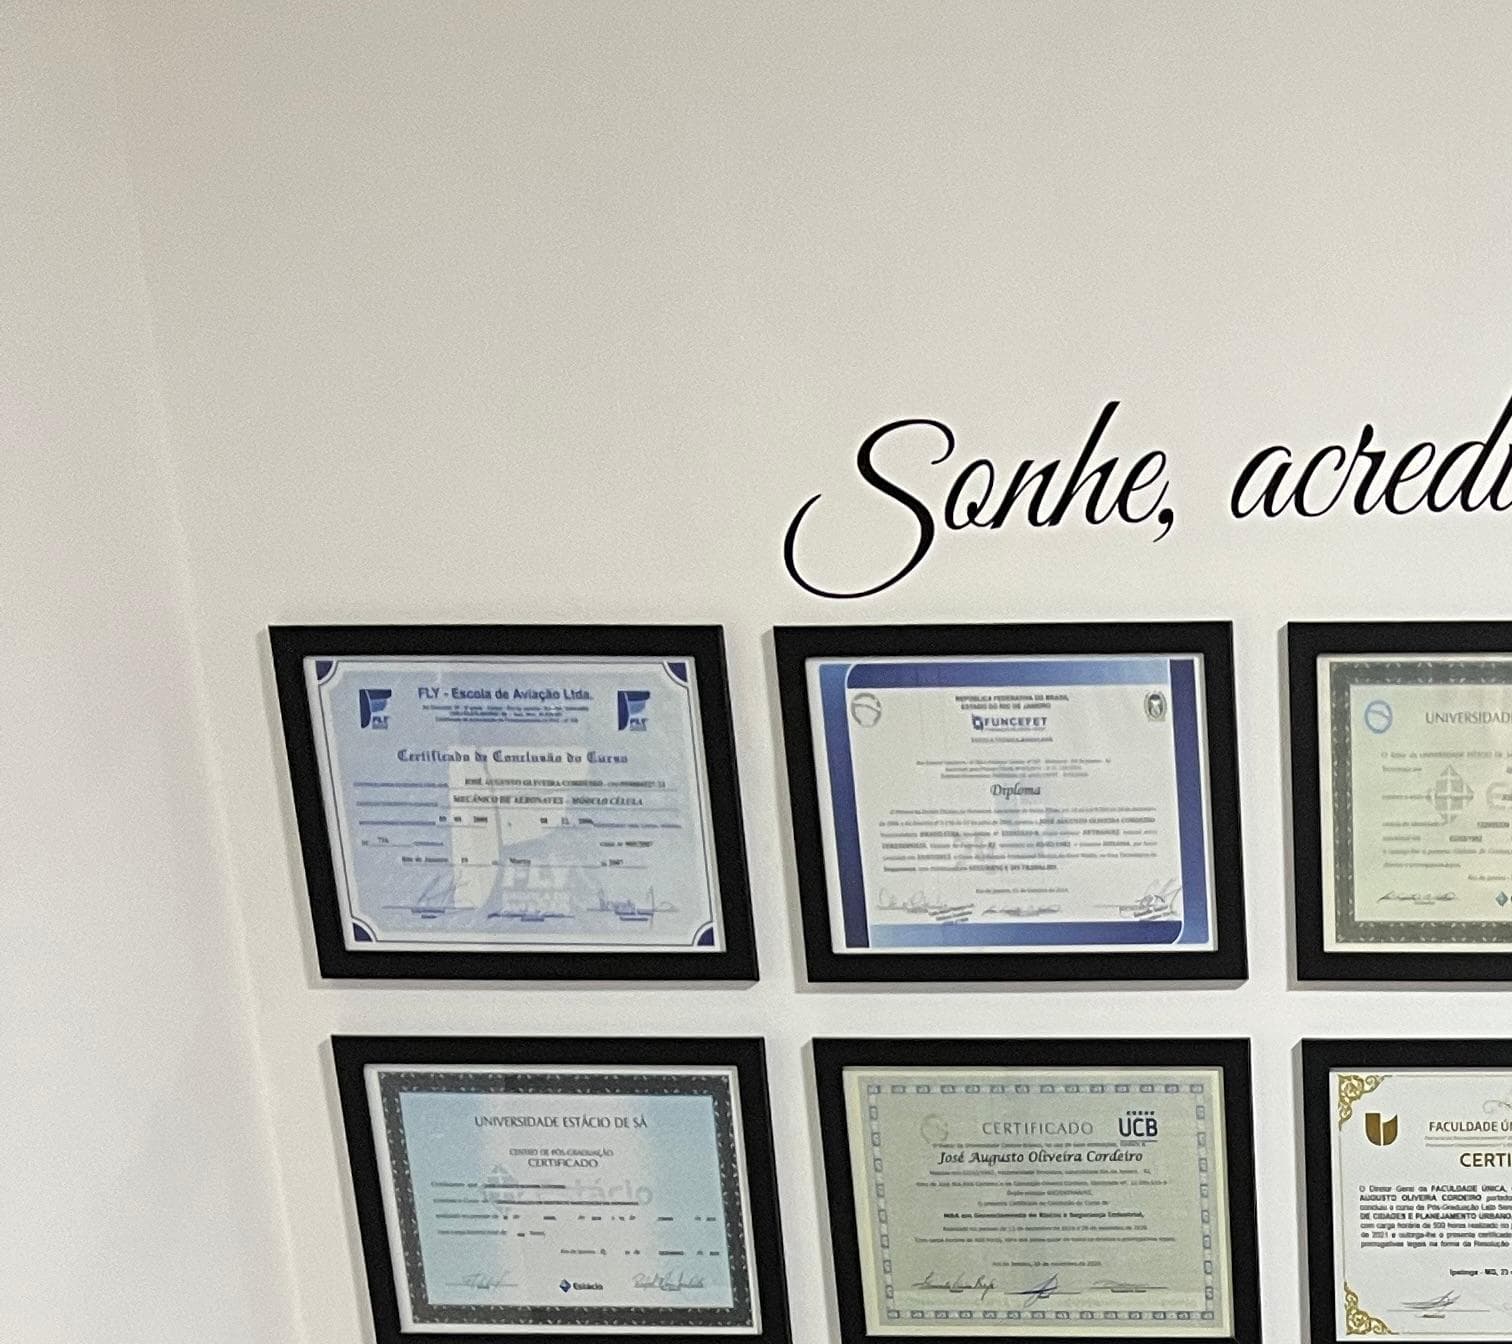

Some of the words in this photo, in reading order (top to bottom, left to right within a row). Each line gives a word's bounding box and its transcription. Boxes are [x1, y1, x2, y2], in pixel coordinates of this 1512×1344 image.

[784, 407, 1173, 599] Sonhe,
[418, 687, 440, 699] FLY
[452, 687, 492, 699] Escola
[495, 688, 509, 699] de
[514, 689, 560, 701] Aviação
[563, 689, 592, 700] Ltda.
[984, 717, 1046, 726] FUNCEFET
[398, 750, 470, 764] Certificado
[475, 751, 487, 762] de
[493, 750, 561, 762] Conclusão
[567, 753, 581, 763] do
[587, 751, 628, 763] Curso
[990, 783, 1040, 800] Diploma
[475, 1116, 558, 1127] UNIVERSIDADE
[563, 1115, 610, 1128] ESTÁCIO
[614, 1117, 629, 1128] DE
[633, 1115, 648, 1128] SÁ
[982, 1121, 1093, 1136] CERTIFICADO
[1119, 1118, 1157, 1137] UCB
[1430, 1121, 1498, 1132] FACULDADE
[528, 1159, 598, 1167] CERTIFICADO
[938, 1151, 964, 1165] José
[968, 1152, 1024, 1166] Augusto
[1028, 1150, 1082, 1162] Oliveira
[1087, 1150, 1142, 1162] Cordeiro
